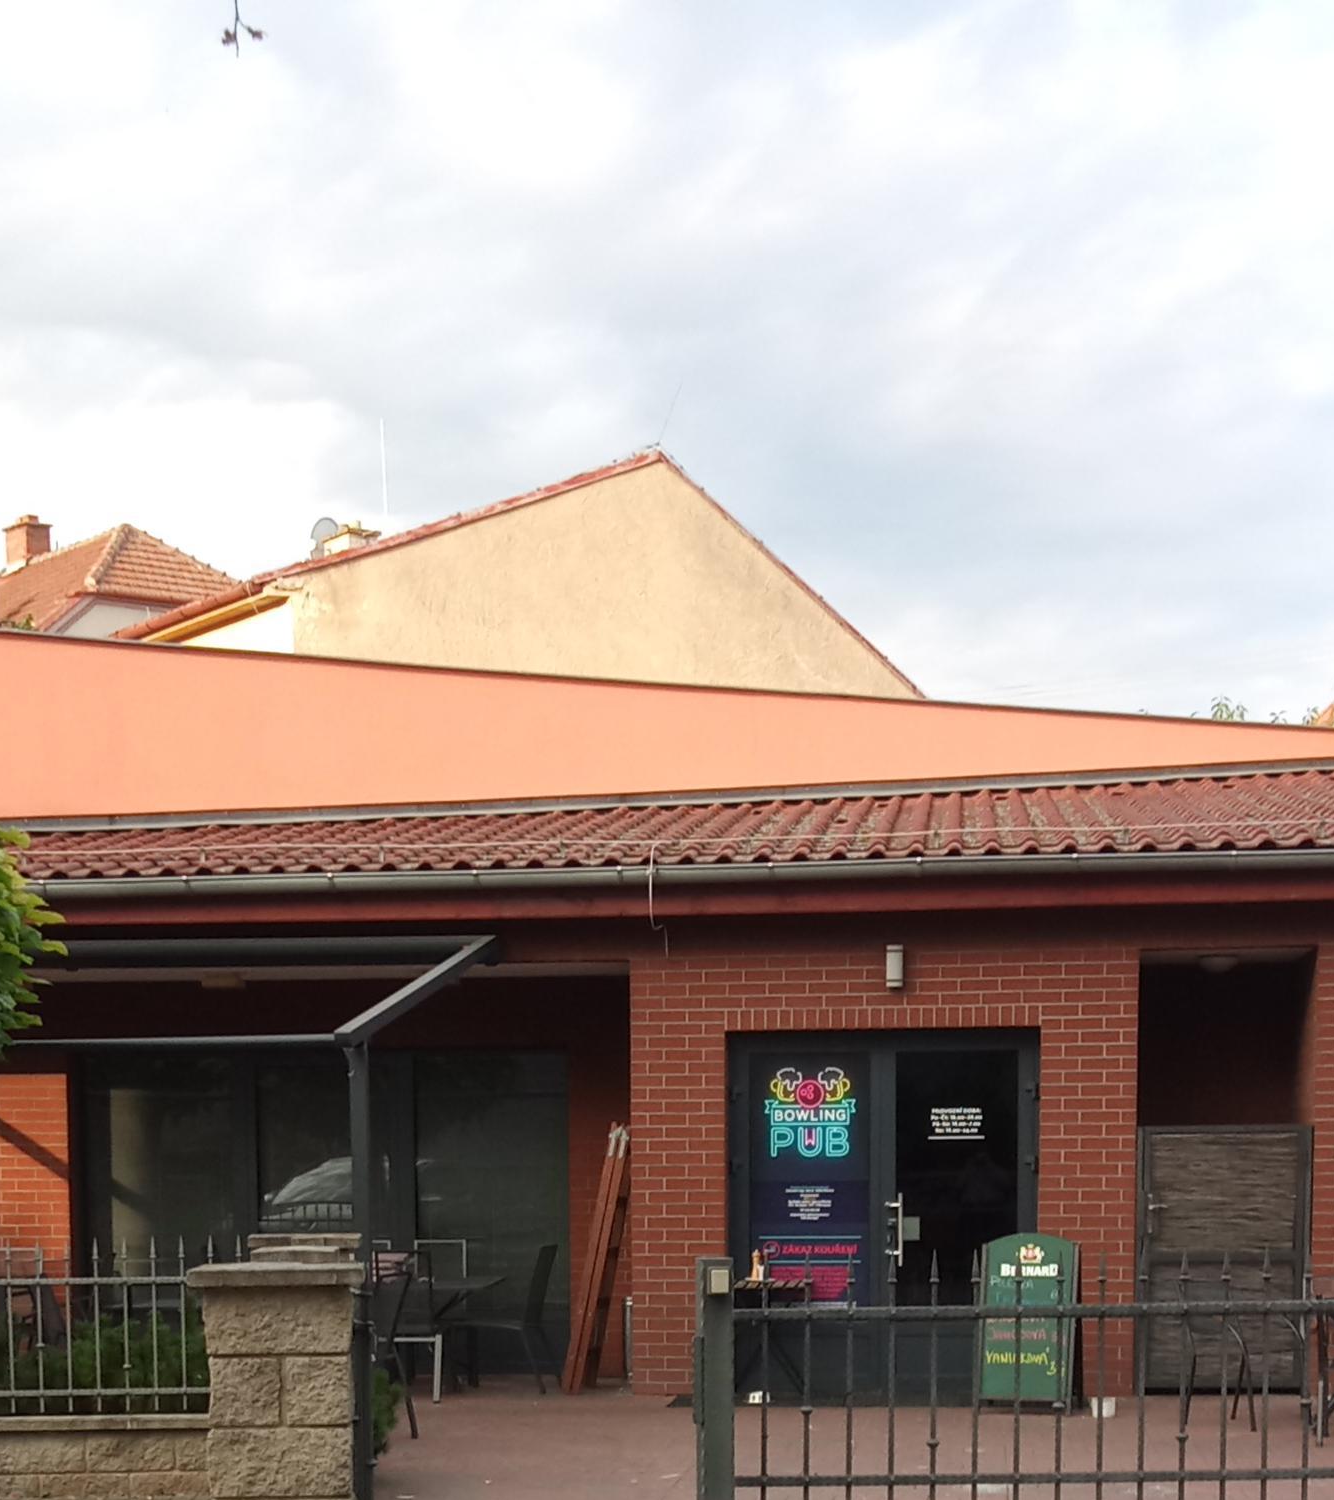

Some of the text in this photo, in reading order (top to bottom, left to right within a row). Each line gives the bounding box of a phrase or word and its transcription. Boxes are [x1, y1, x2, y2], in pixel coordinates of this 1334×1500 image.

[774, 1109, 847, 1122] BOWLING
[770, 1126, 850, 1158] PUB
[781, 1243, 813, 1254] ZÁKAZ
